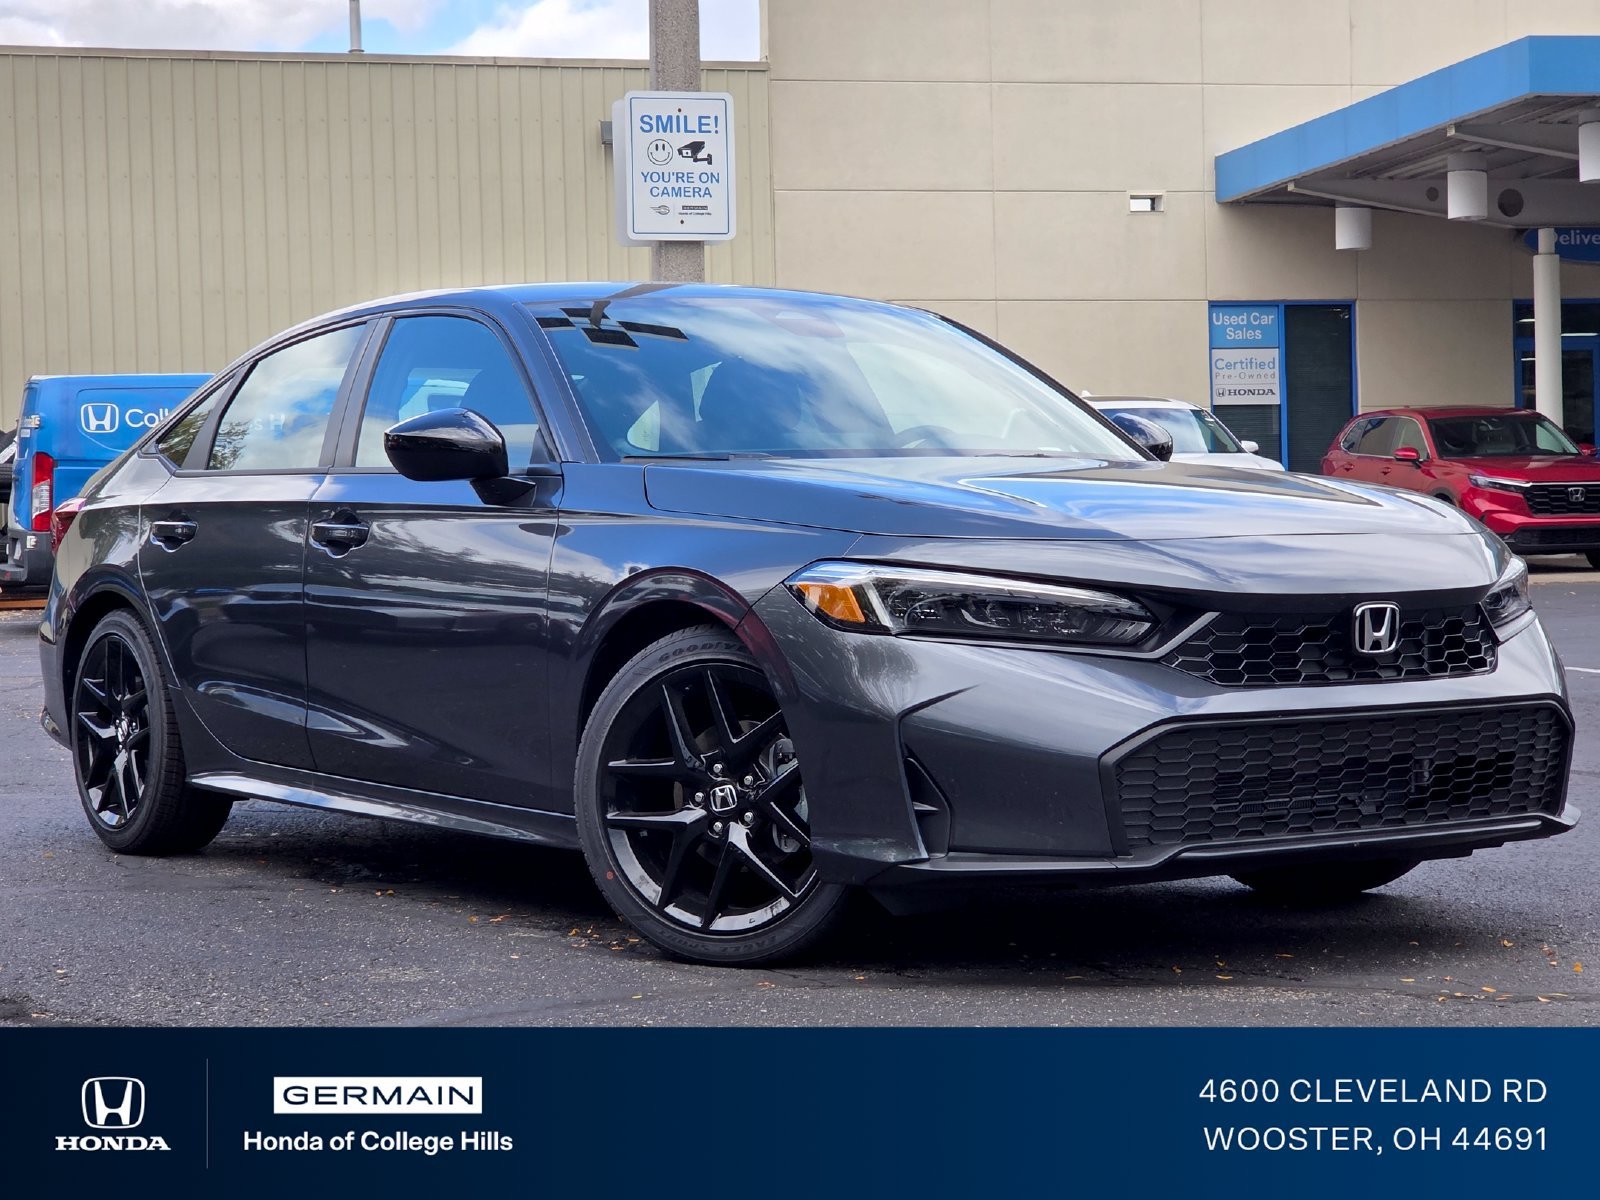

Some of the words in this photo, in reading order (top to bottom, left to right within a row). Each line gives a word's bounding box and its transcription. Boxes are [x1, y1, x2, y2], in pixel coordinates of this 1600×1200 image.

[640, 114, 719, 134] SMILE!
[641, 172, 695, 183] YOU'RE
[699, 172, 720, 184] ON
[650, 186, 713, 198] CAMERA
[1554, 229, 1600, 245] elive
[1213, 312, 1247, 325] Used
[1250, 312, 1275, 325] Car
[1226, 327, 1262, 340] Sales
[1214, 357, 1276, 370] Certified
[1215, 371, 1276, 380] Pre-Owned
[1228, 389, 1275, 397] HONDA
